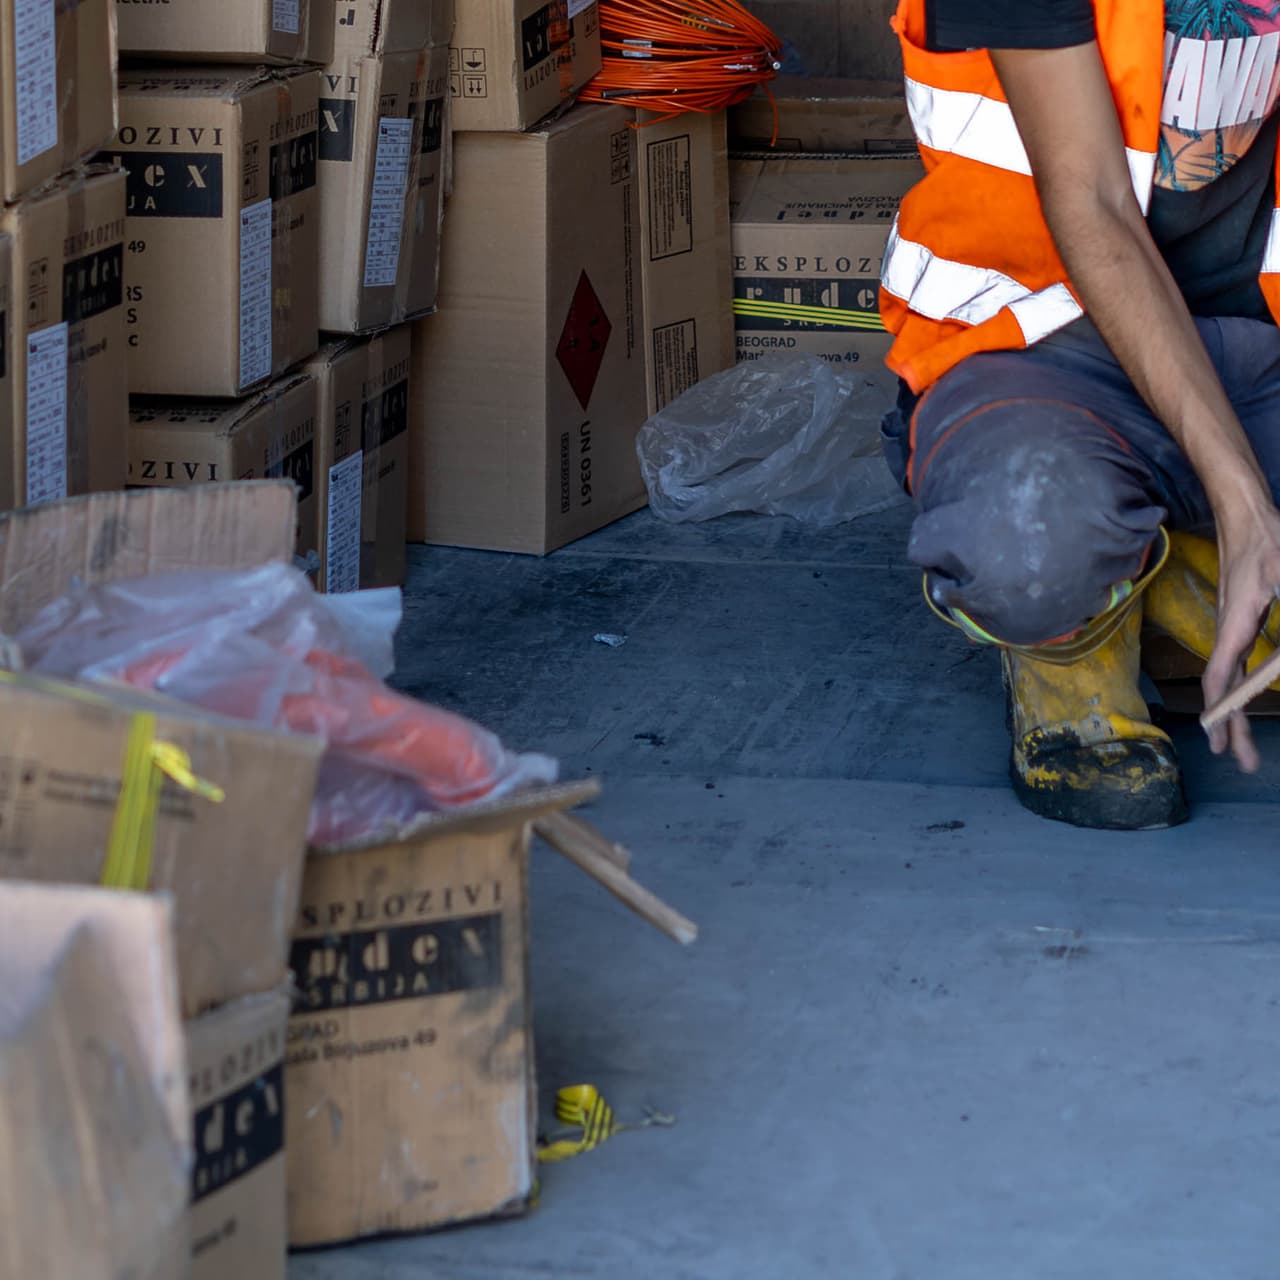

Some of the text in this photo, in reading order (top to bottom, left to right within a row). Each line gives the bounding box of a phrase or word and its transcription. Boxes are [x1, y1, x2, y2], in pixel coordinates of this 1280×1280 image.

[735, 256, 882, 272] EKSPLOZ
[747, 282, 875, 308] rude
[736, 337, 796, 347] BEOGRAD
[581, 420, 592, 507] UN 0361
[301, 881, 506, 928] SPLOZIVI
